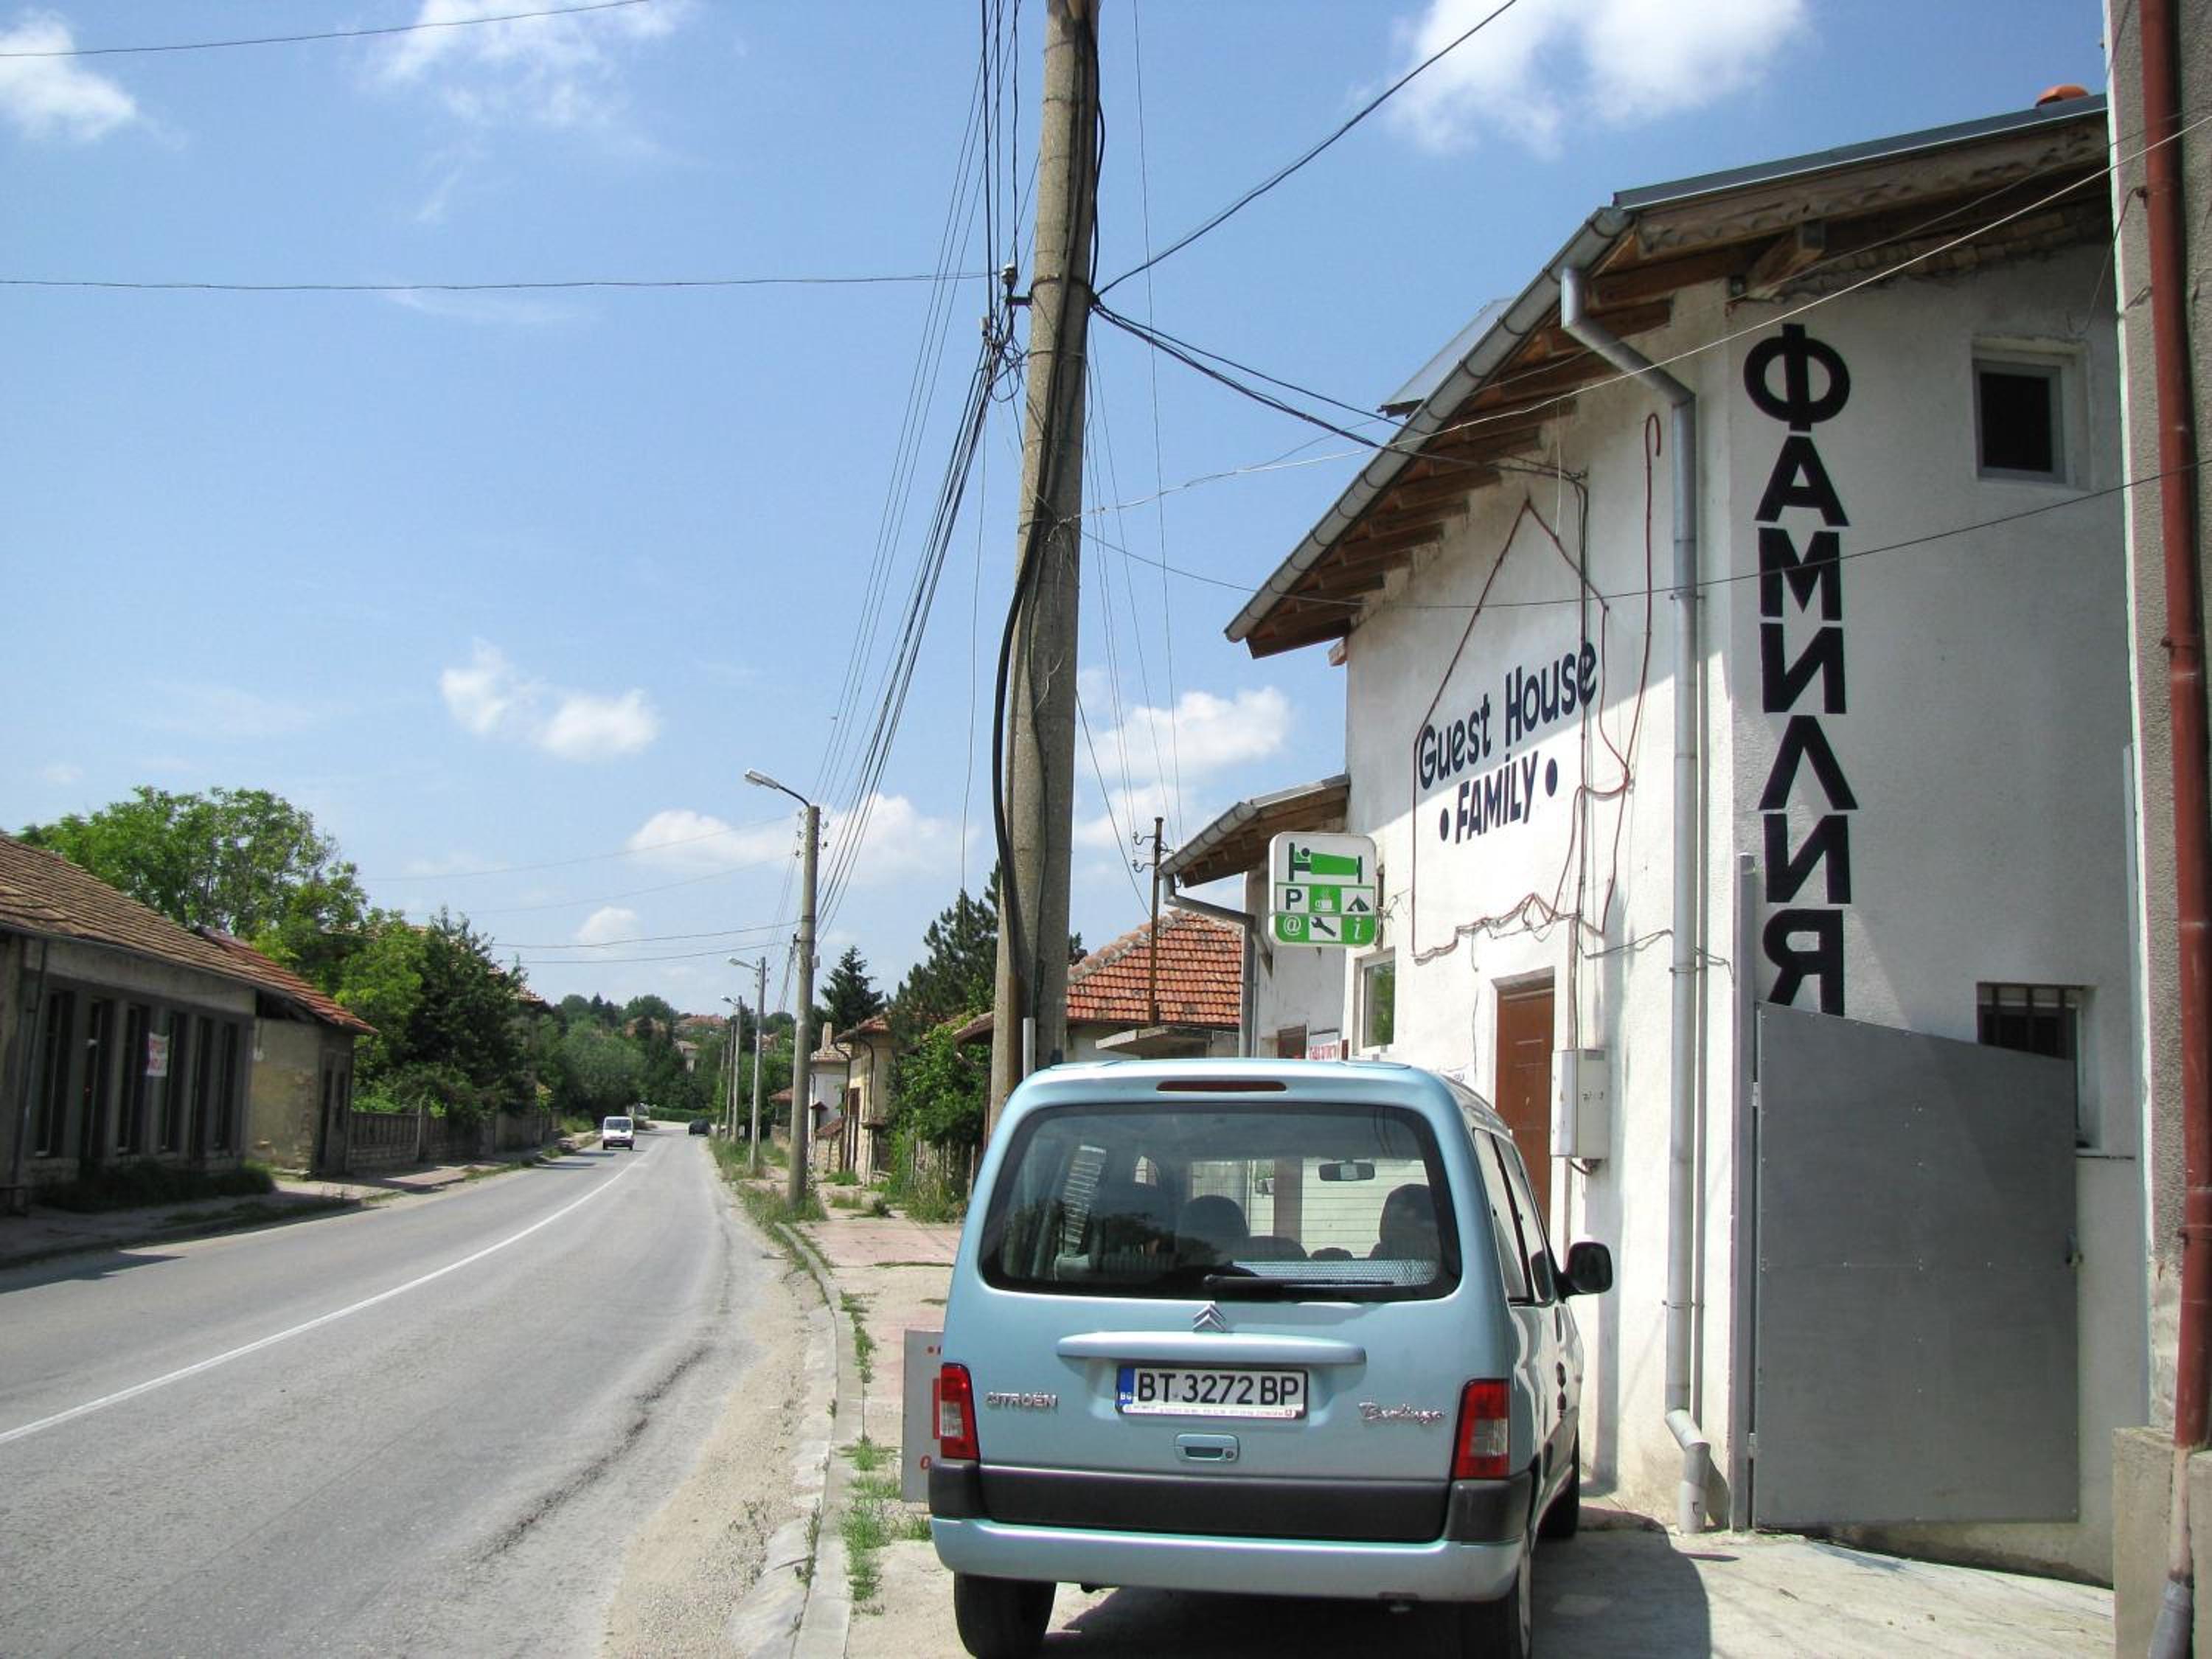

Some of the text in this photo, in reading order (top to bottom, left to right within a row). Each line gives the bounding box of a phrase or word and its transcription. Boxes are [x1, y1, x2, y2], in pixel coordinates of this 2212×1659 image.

[1419, 641, 1597, 790] Guest House
[1743, 323, 1859, 1017] ФАМИЛИЯ
[1286, 888, 1302, 910] P
